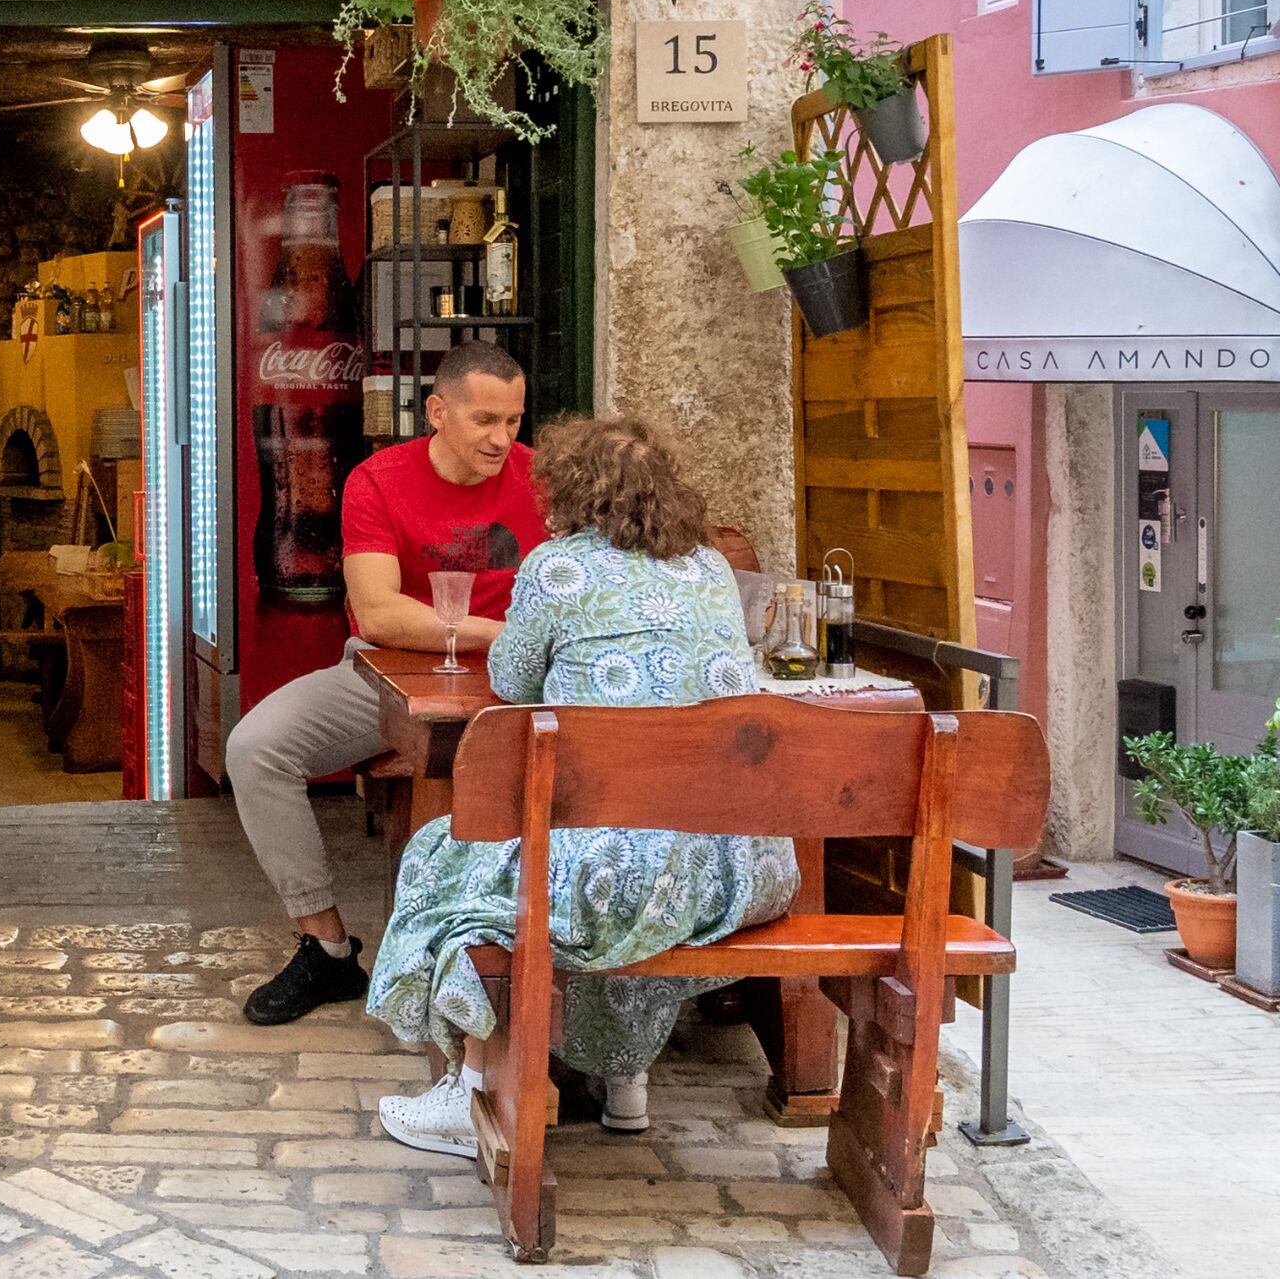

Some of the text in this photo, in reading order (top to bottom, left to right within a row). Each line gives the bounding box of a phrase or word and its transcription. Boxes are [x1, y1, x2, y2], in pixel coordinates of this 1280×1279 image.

[664, 33, 718, 74] 15
[651, 100, 733, 112] BREGOVITA
[976, 348, 1271, 371] CASA AMANDO
